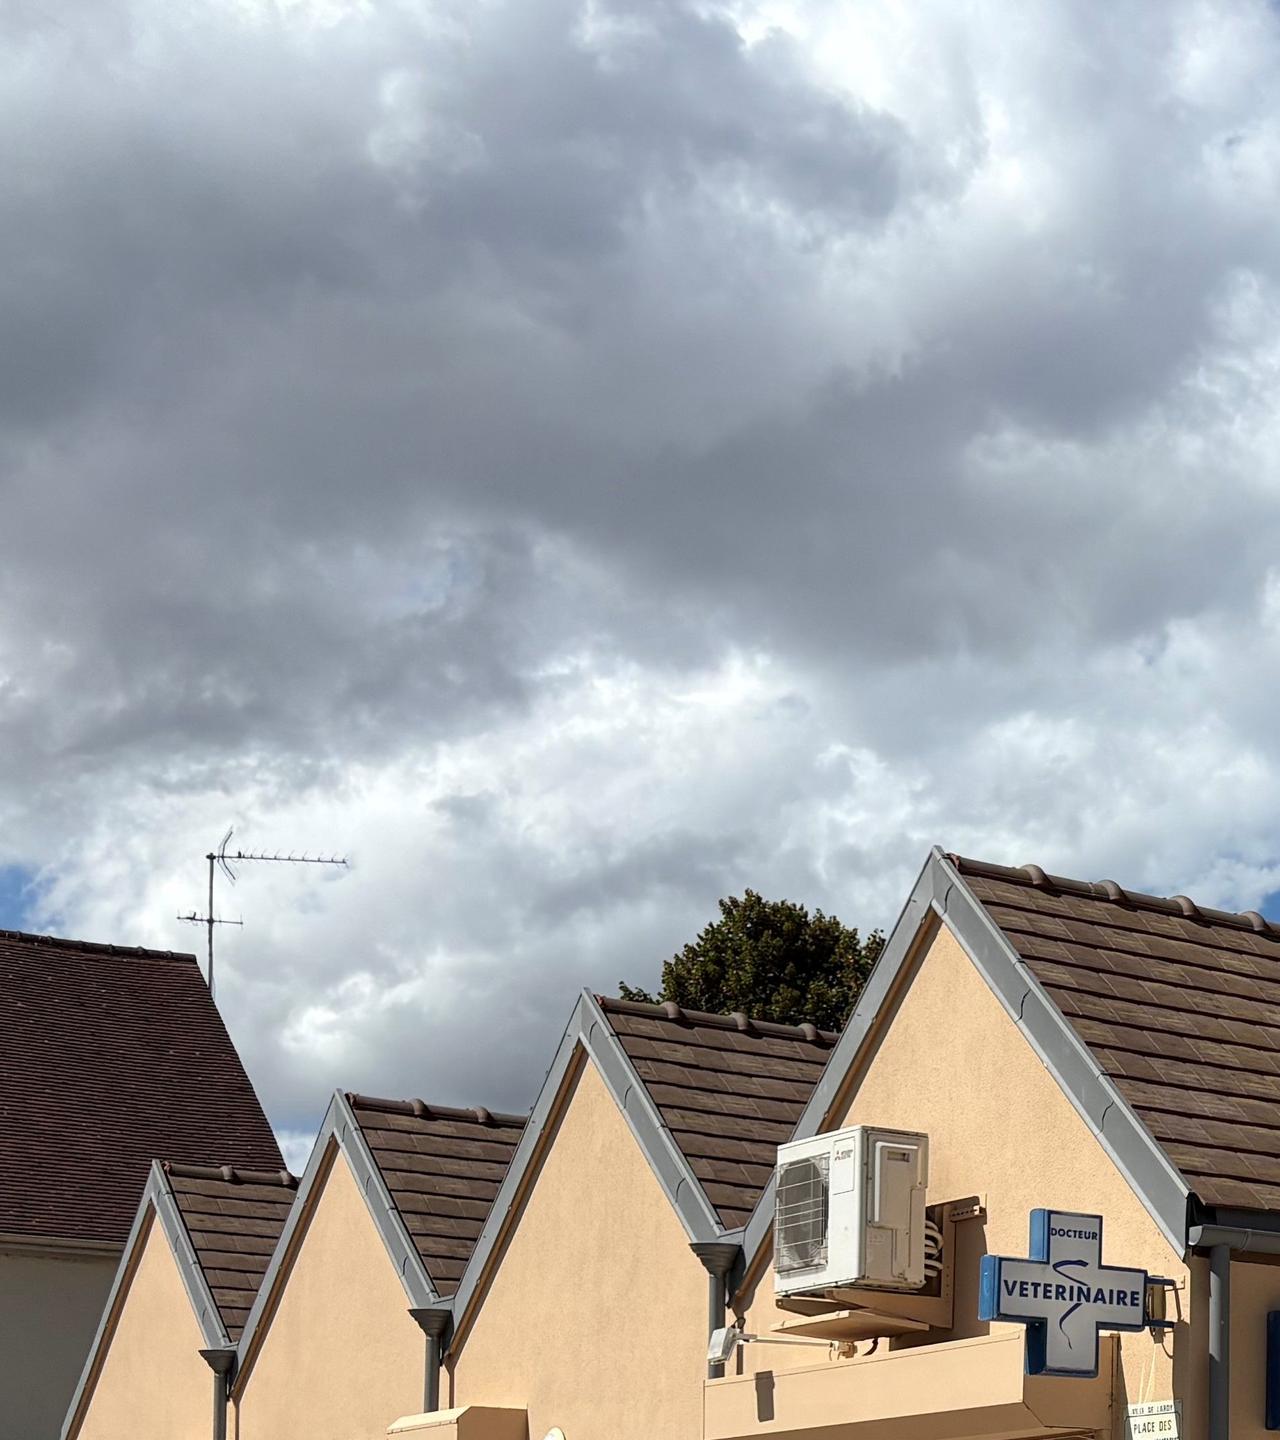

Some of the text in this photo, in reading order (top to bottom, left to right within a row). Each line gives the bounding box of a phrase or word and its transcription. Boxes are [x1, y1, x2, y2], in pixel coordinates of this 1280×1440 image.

[1050, 1227, 1098, 1241] DOCTEUR
[1003, 1279, 1140, 1307] VETERINAIRE
[1133, 1419, 1172, 1434] PLACE DES
